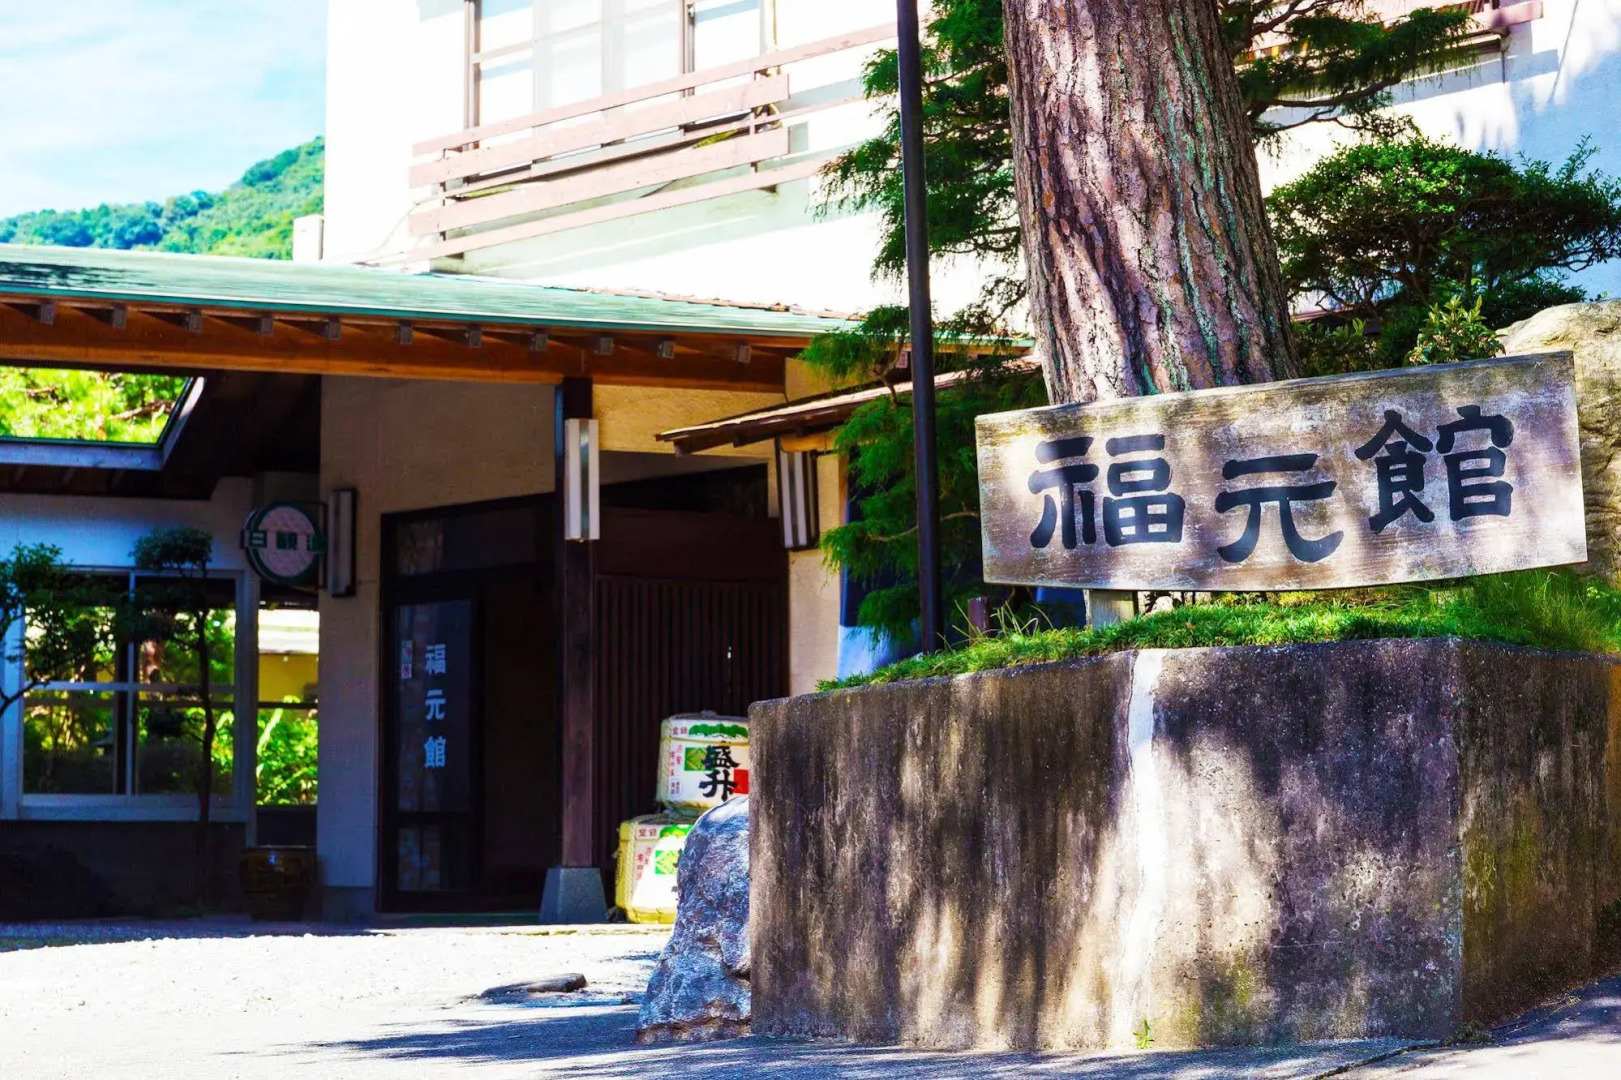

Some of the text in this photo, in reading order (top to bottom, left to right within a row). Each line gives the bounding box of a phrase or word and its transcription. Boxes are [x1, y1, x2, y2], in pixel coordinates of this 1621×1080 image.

[1028, 404, 1515, 563] 福元館
[424, 643, 447, 769] 福元館
